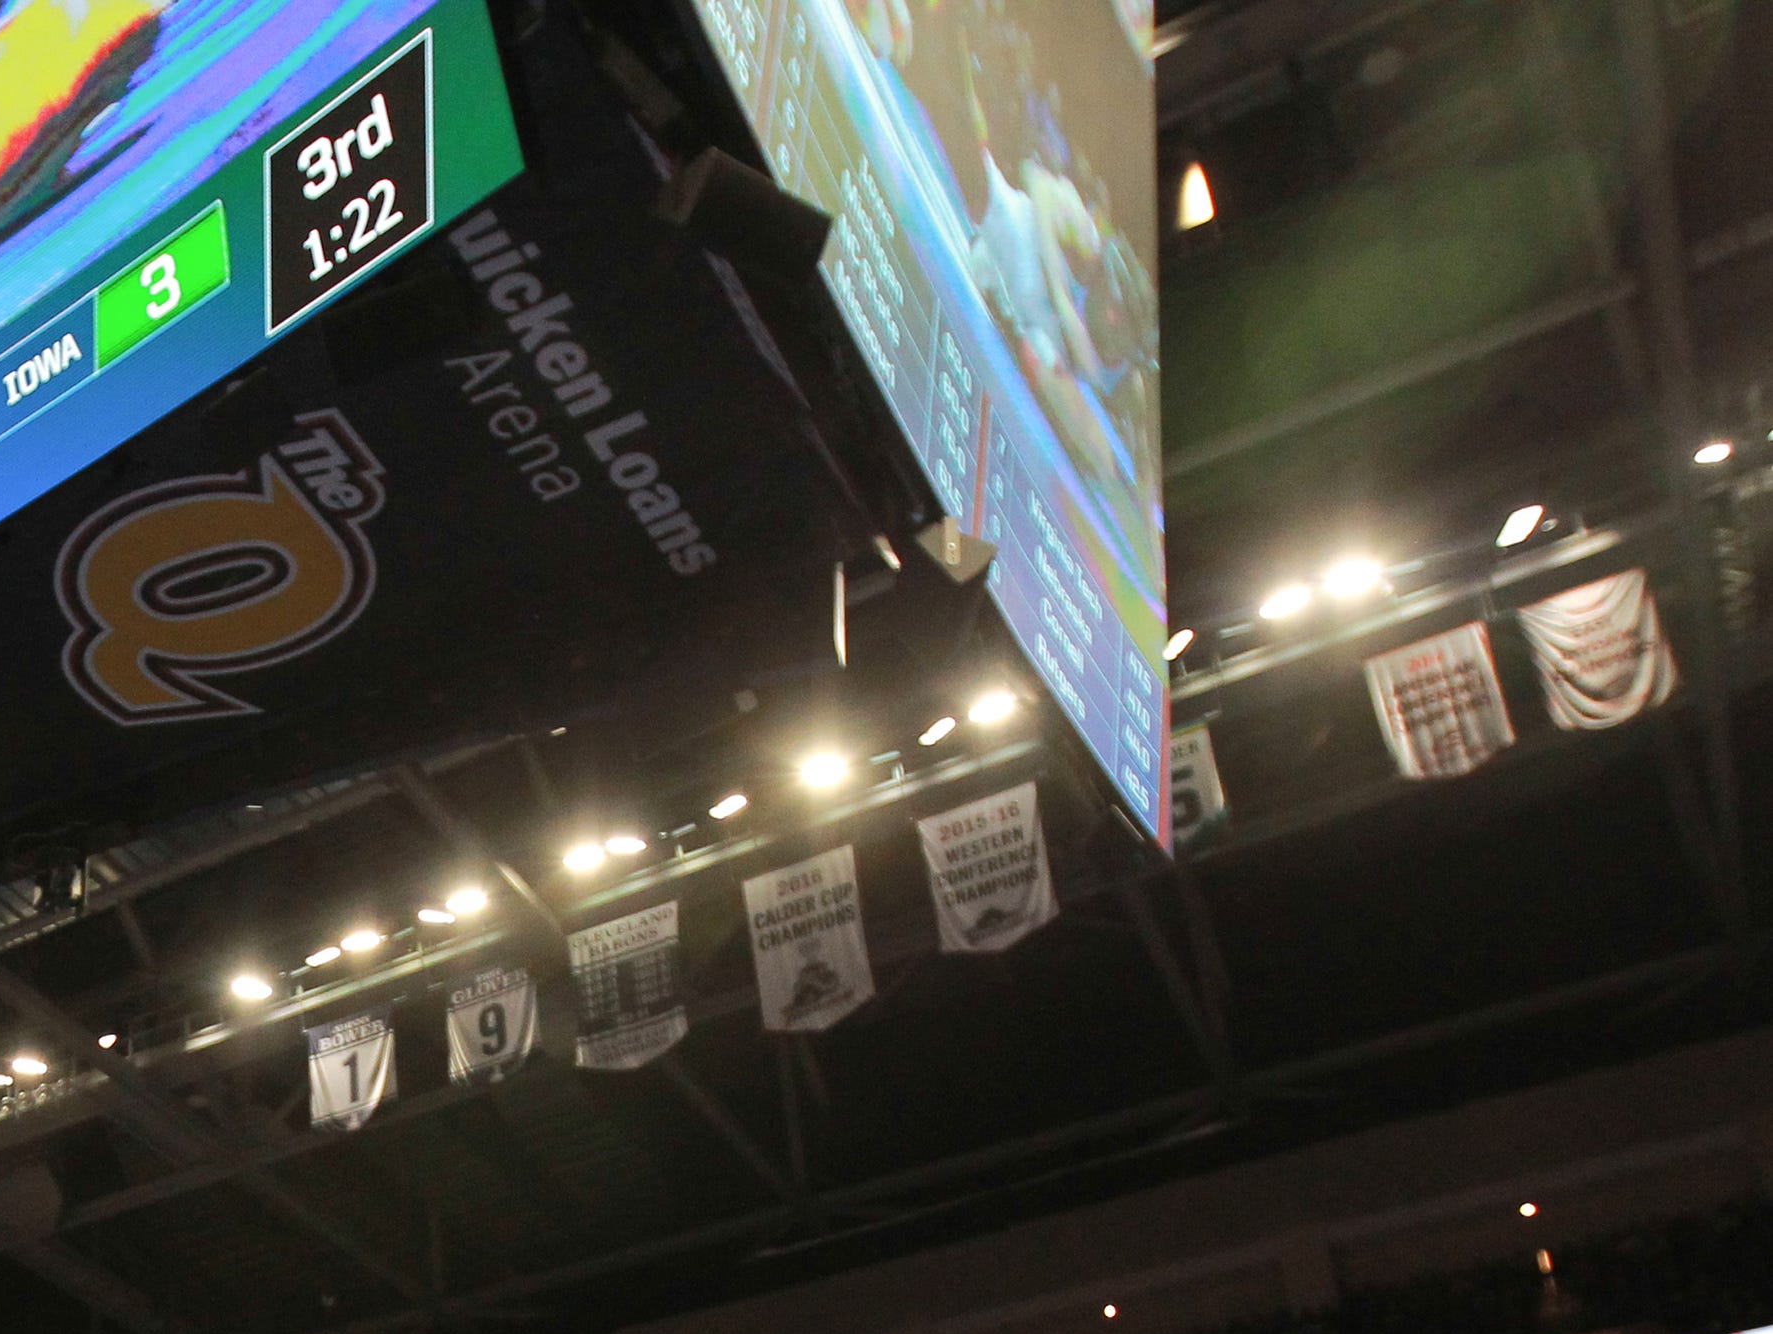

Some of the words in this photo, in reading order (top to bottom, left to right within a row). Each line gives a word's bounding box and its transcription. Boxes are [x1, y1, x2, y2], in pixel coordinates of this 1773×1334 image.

[296, 93, 394, 200] 3rd
[302, 178, 404, 281] 1:22
[140, 252, 182, 320] 3
[1, 332, 83, 406] IOWA
[447, 207, 612, 418] uicken
[584, 410, 717, 577] Loans
[444, 347, 582, 501] Arena
[945, 826, 1024, 866] WESTERN
[754, 895, 817, 930] CALDER
[820, 881, 854, 906] CUP
[943, 863, 1040, 908] CHAMPIONS
[758, 903, 856, 951] CHAMPIONS
[318, 1019, 386, 1052] BOWER
[479, 1002, 507, 1056] 9
[341, 1049, 360, 1103] 1
